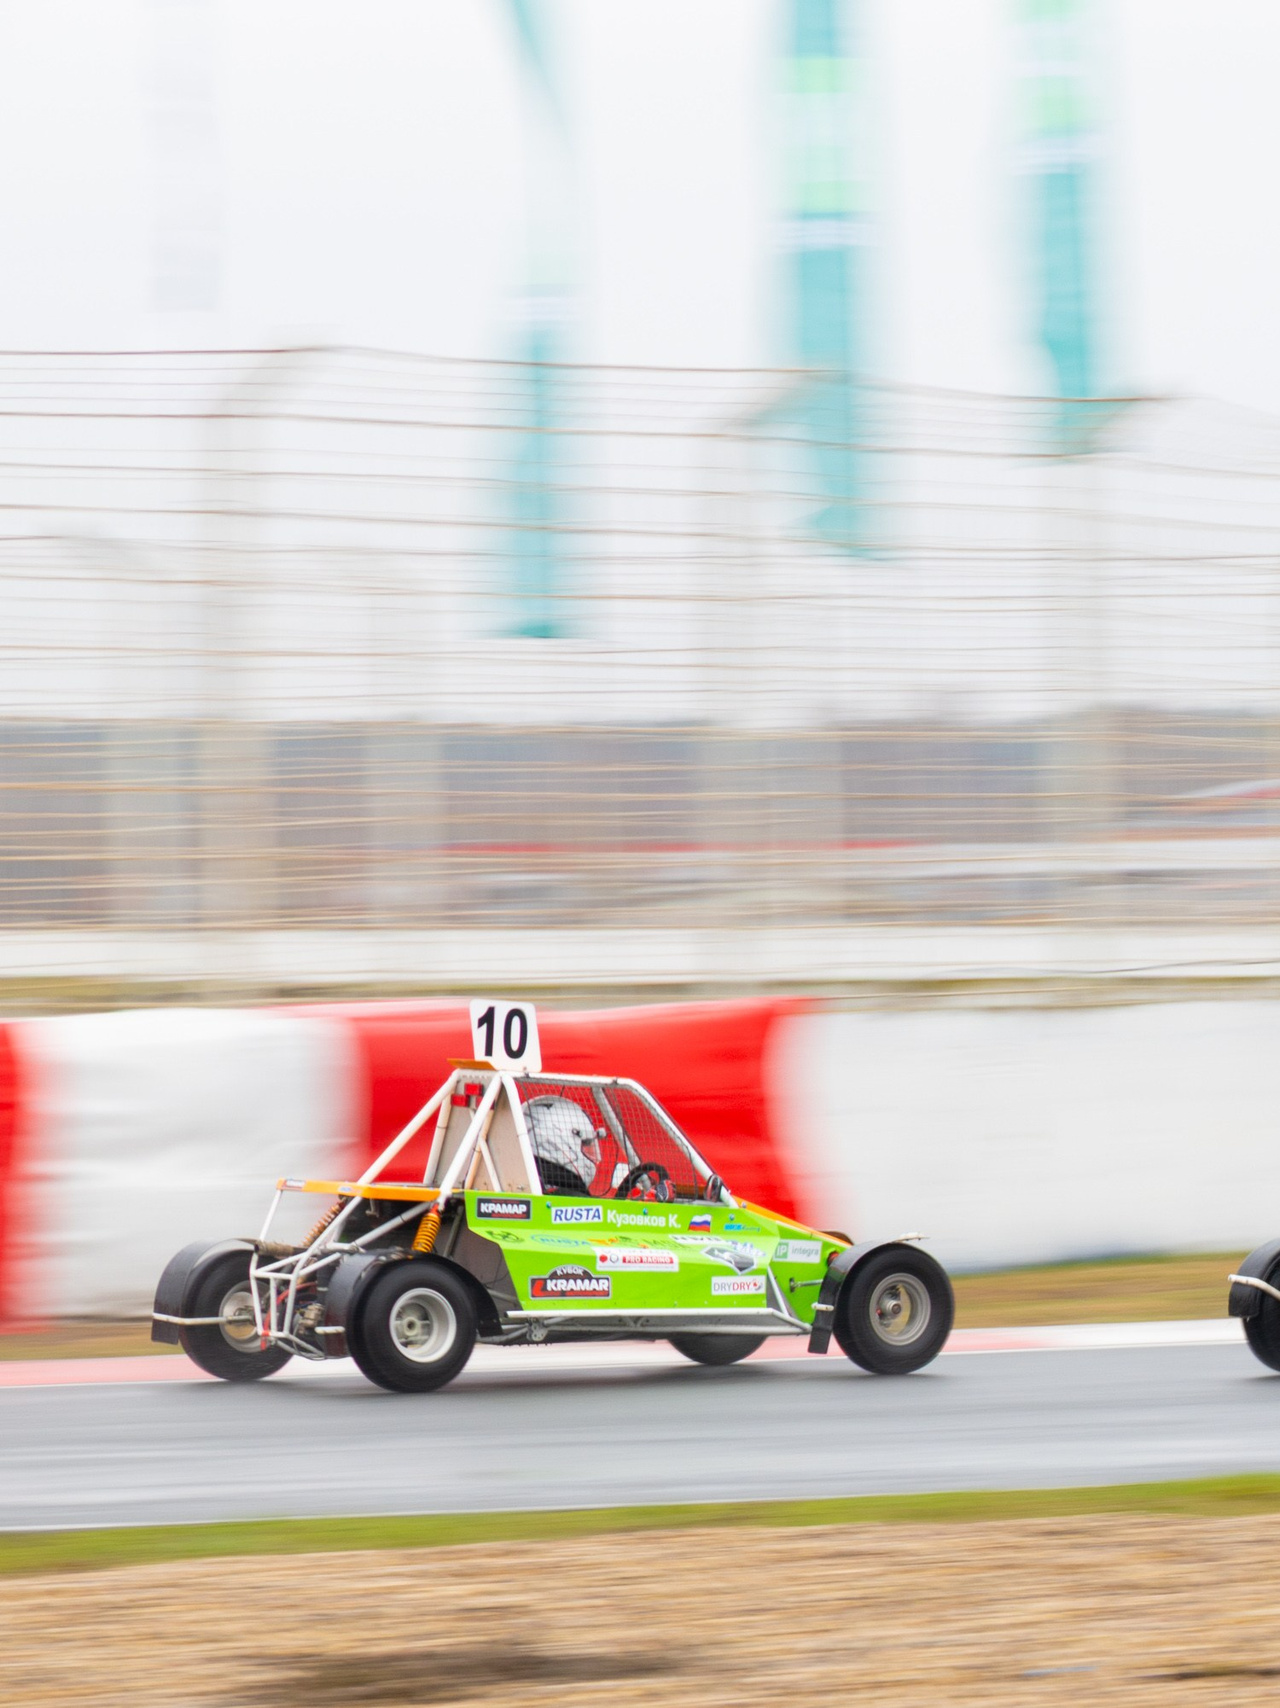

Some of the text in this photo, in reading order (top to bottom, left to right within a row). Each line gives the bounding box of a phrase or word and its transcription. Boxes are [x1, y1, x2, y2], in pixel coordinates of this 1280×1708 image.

[477, 1006, 528, 1059] 10
[480, 1202, 527, 1214] КРАМАР
[554, 1208, 601, 1221] RUSTA
[607, 1210, 681, 1228] Кузовков К.
[791, 1246, 819, 1257] integra
[546, 1279, 609, 1291] KRAMAR
[713, 1281, 751, 1292] DRYDRY
